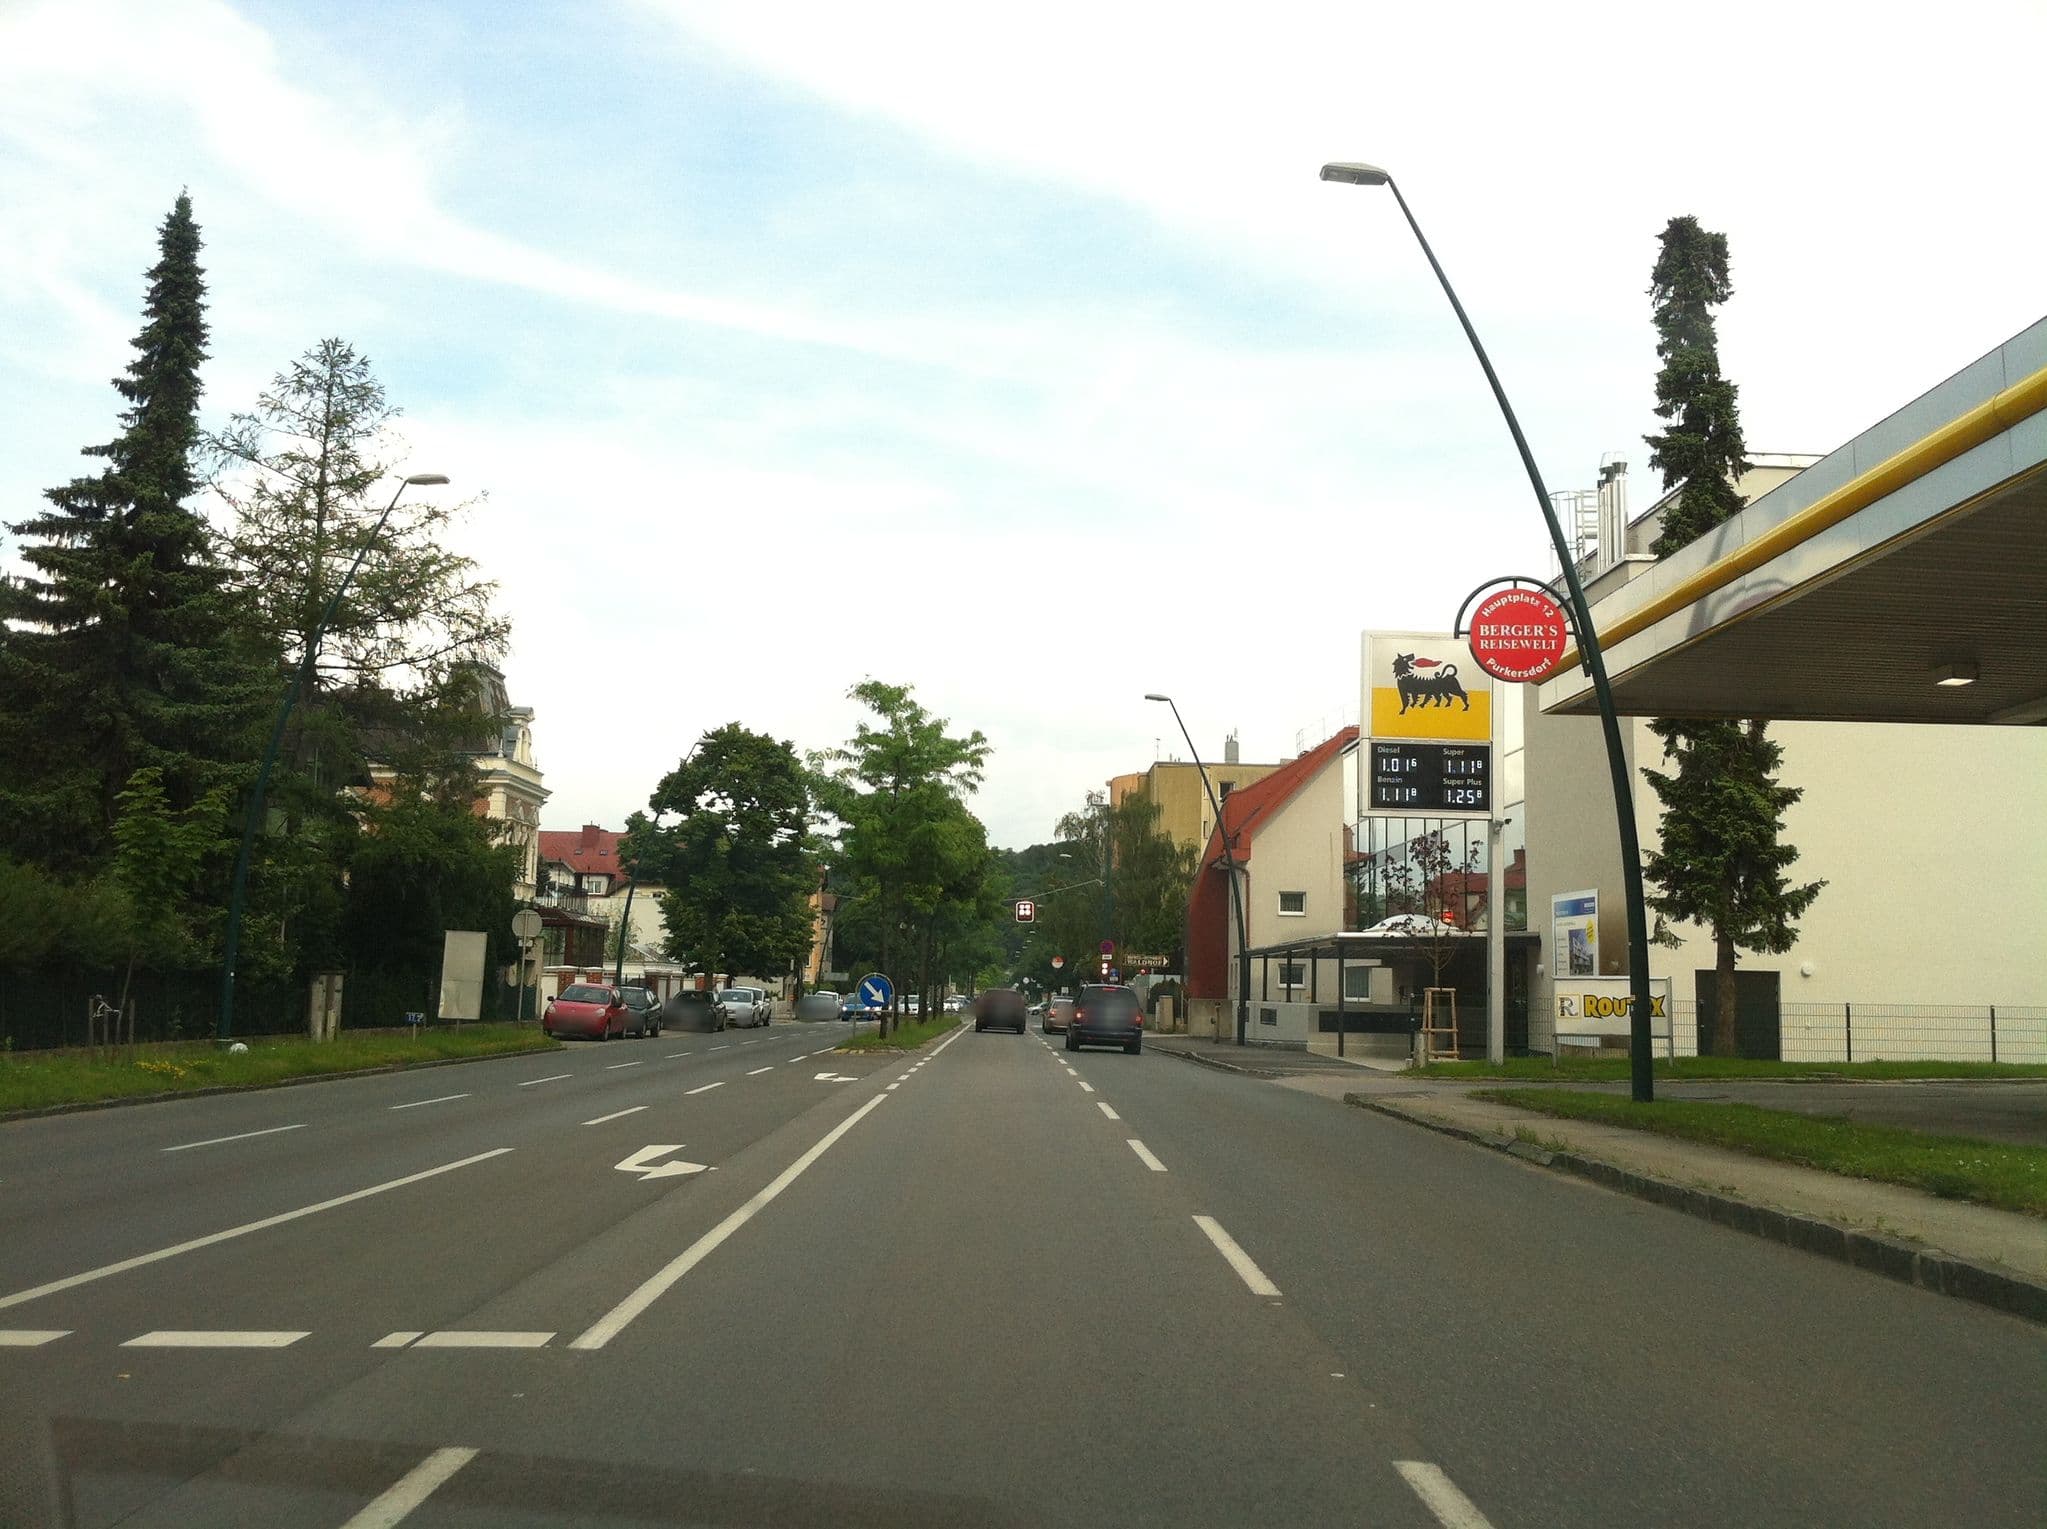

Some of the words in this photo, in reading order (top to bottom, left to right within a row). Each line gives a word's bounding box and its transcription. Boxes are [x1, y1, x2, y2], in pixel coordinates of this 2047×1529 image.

[1481, 593, 1541, 617] Hauptplatz
[1542, 604, 1554, 618] 12
[1479, 639, 1557, 650] REISEWELT
[1486, 657, 1552, 678] Purkersdorf
[1377, 746, 1400, 754] Diesel
[1442, 748, 1465, 757] Super
[1377, 775, 1403, 783] Benzin
[1442, 777, 1465, 786] Super
[1466, 778, 1482, 786] Plus
